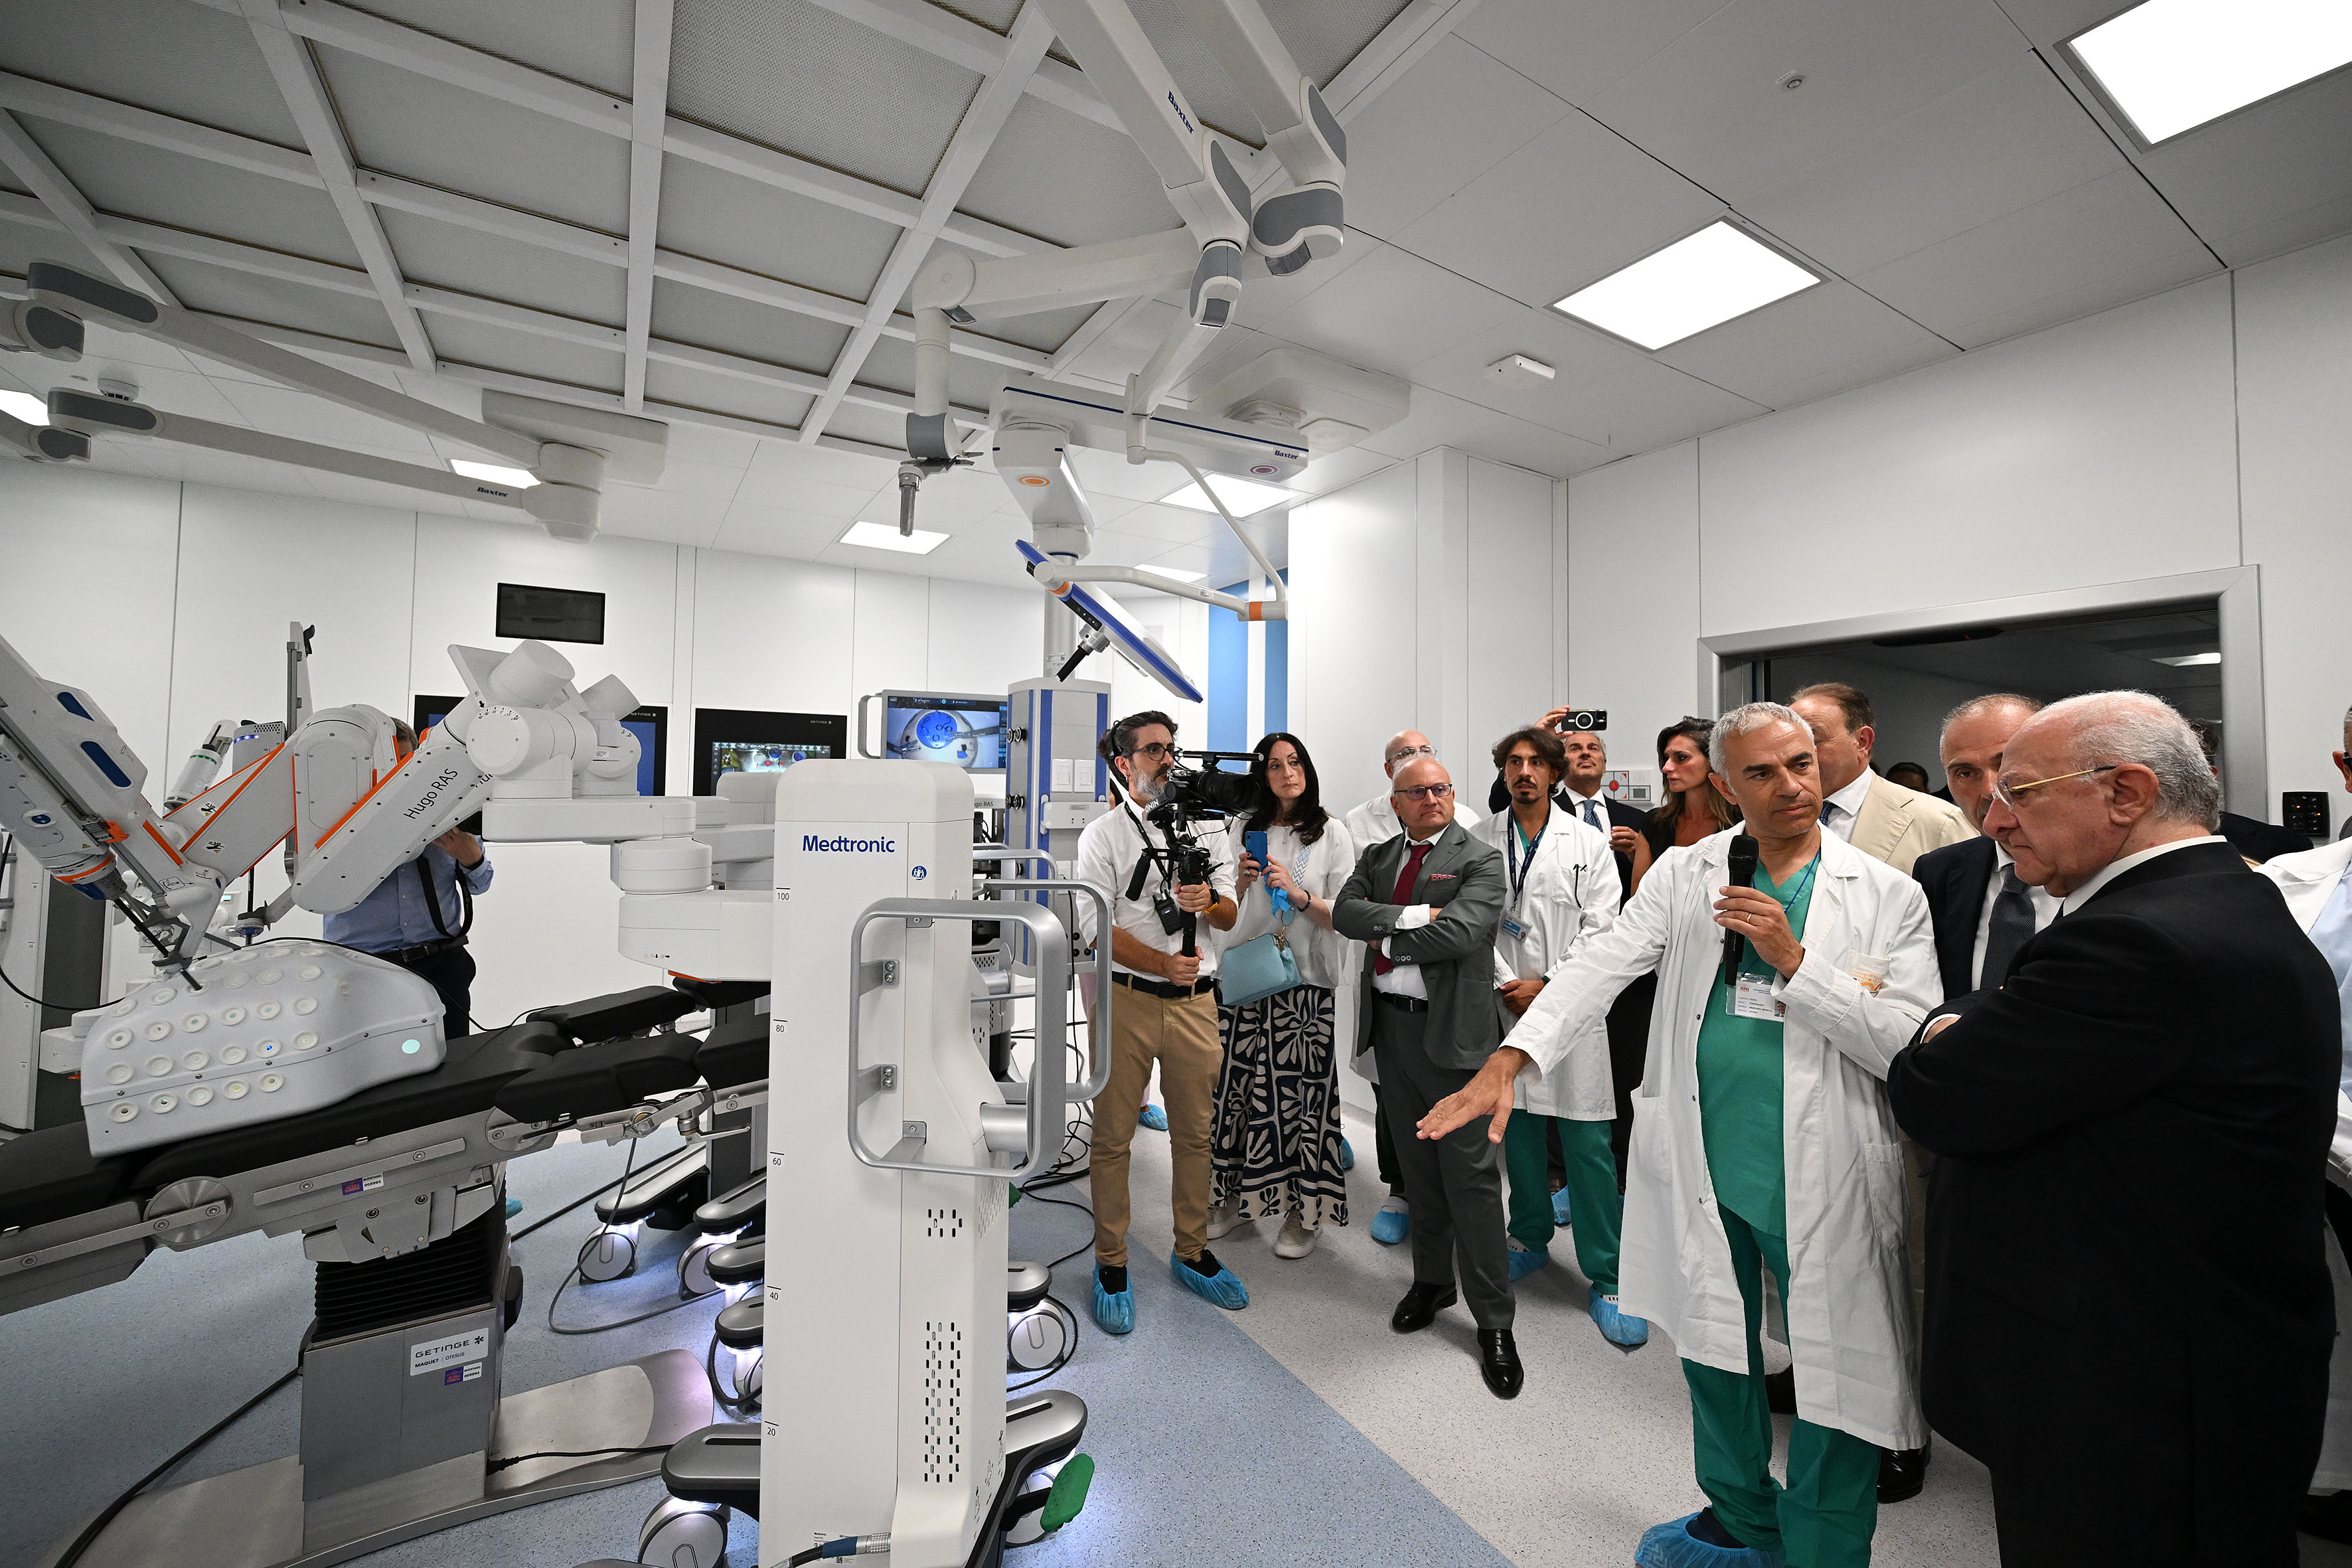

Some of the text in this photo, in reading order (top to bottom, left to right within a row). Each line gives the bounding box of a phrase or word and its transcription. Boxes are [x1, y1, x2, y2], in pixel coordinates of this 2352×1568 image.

[1168, 90, 1194, 134] Baxter
[1275, 450, 1298, 459] Baxter
[477, 487, 509, 497] Baxter
[403, 768, 458, 819] Hugo RAS
[802, 835, 896, 853] Medtronic
[777, 892, 790, 901] 100
[775, 1024, 785, 1033] 80
[773, 1157, 781, 1166] 60
[769, 1292, 779, 1300] 40
[415, 1340, 470, 1358] GETINGE
[415, 1352, 465, 1368] MAQUET OTESUS
[767, 1427, 776, 1437] 20
